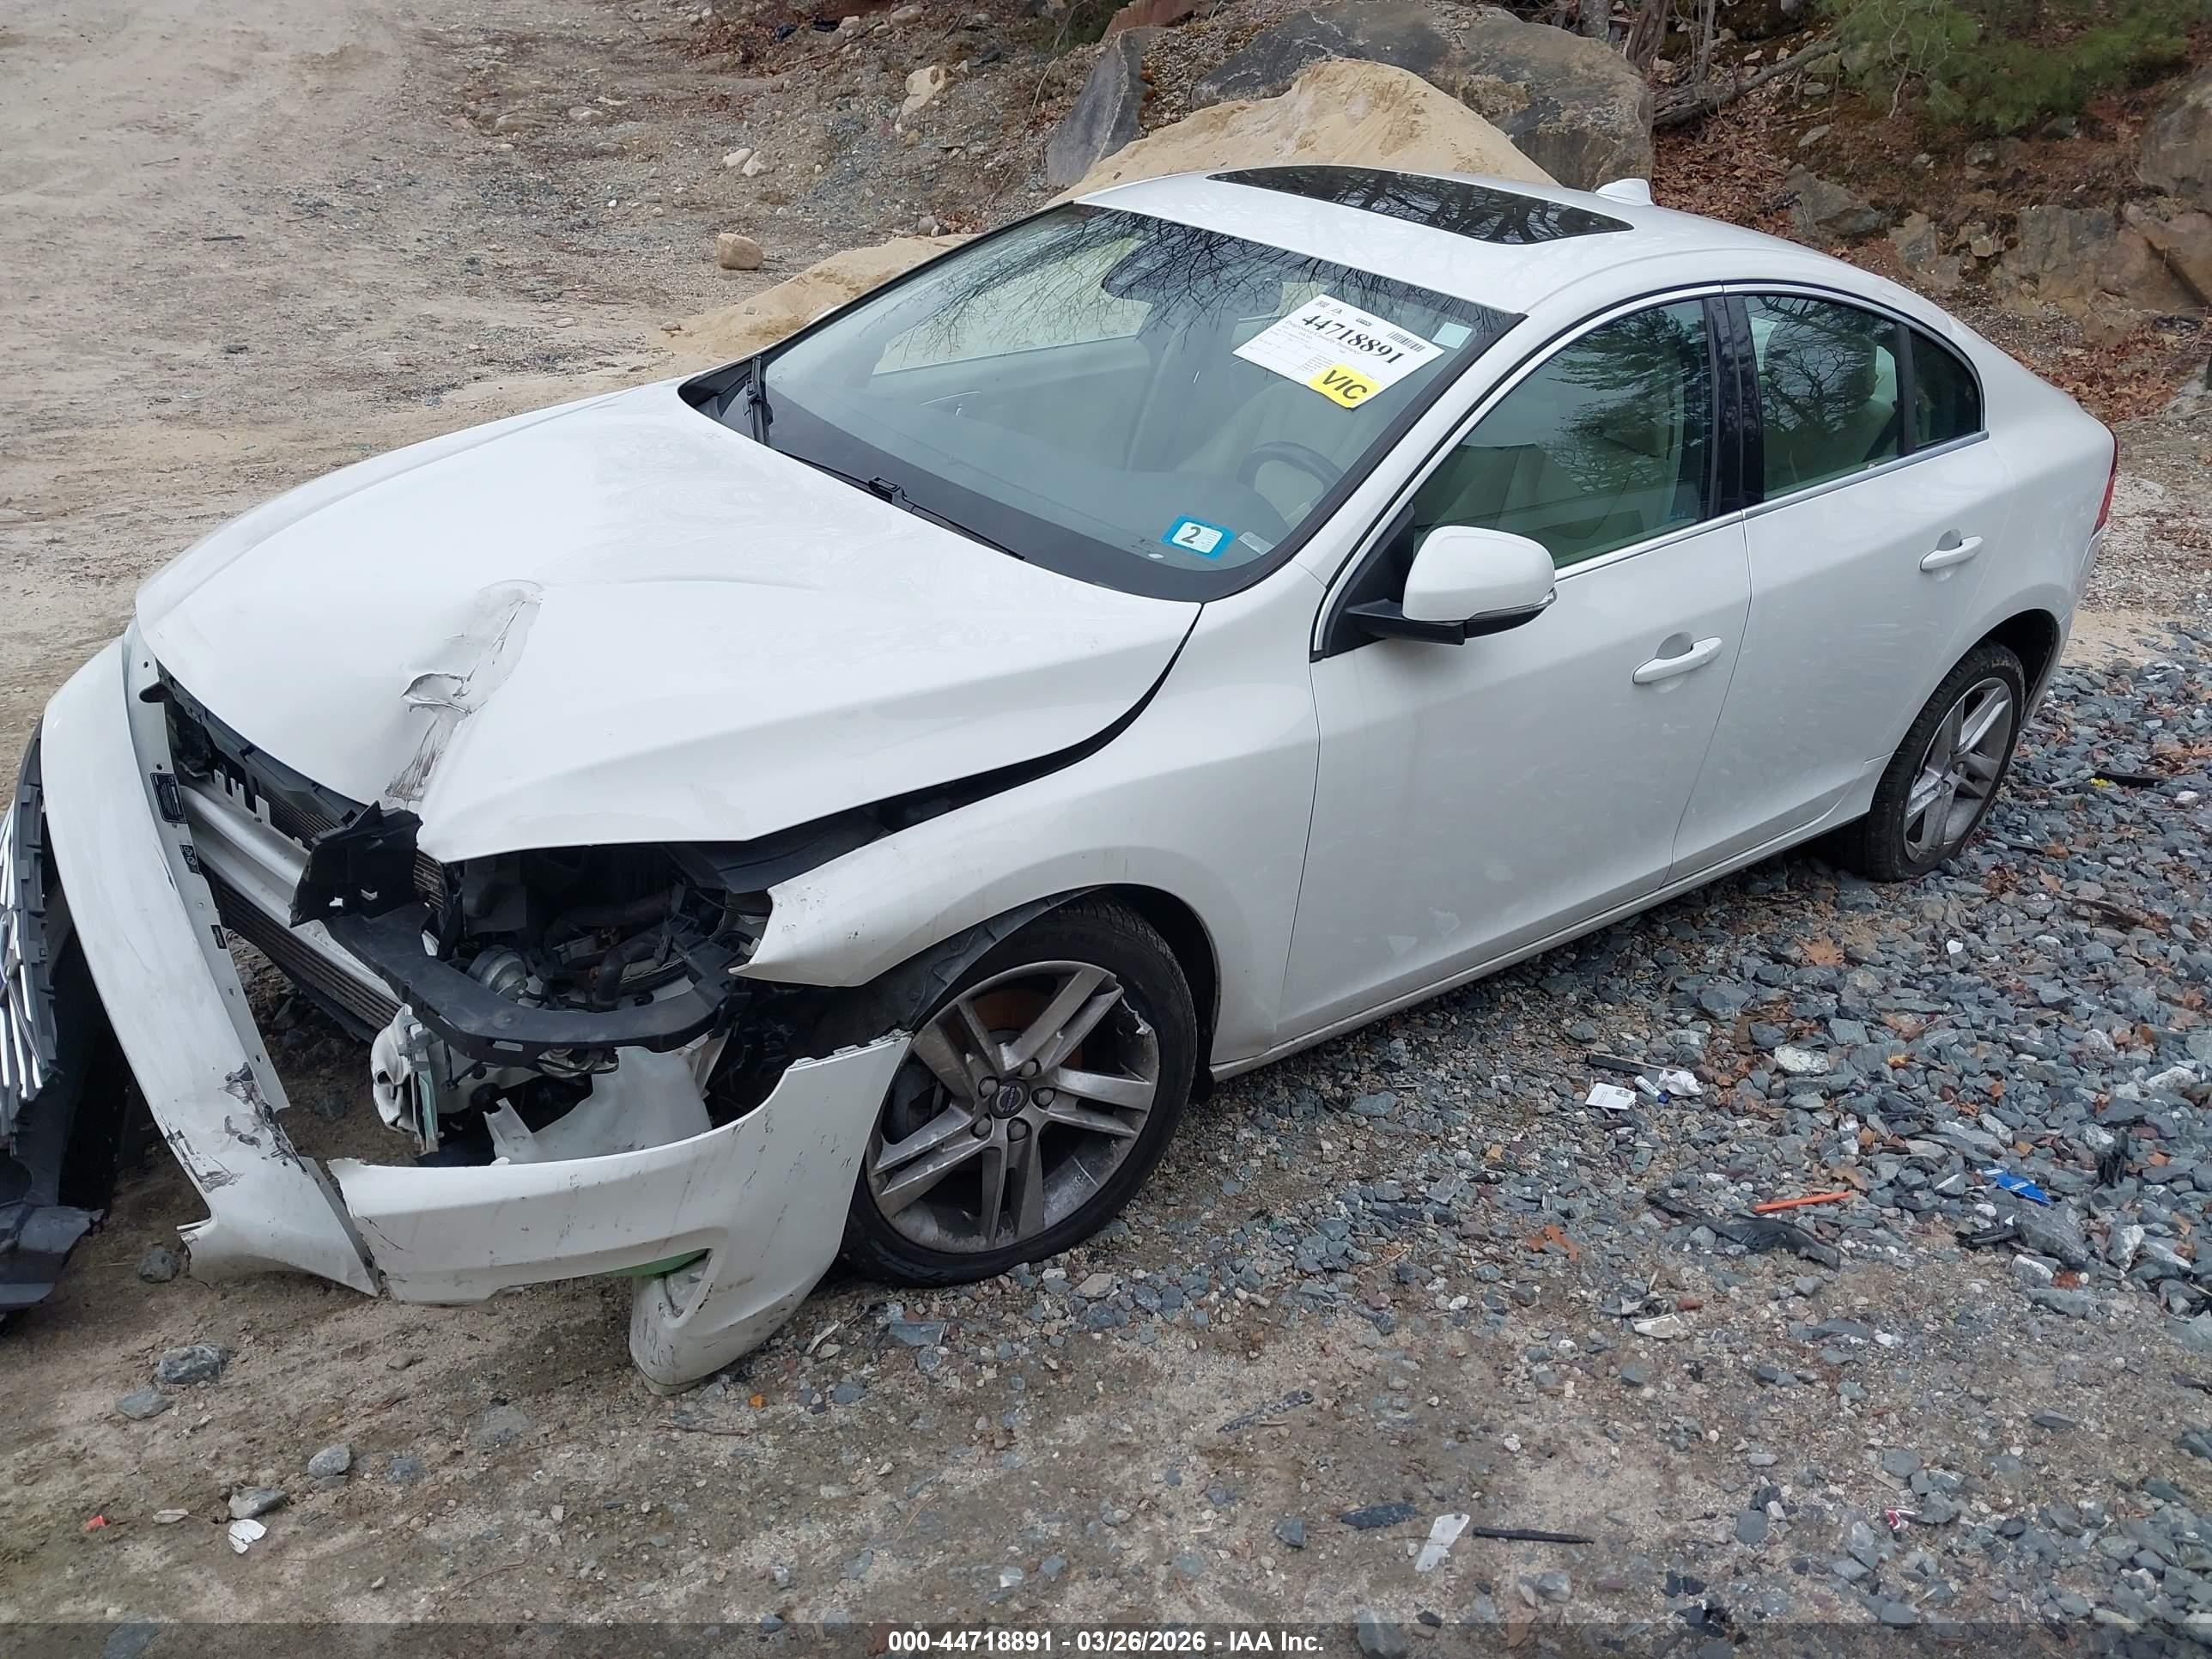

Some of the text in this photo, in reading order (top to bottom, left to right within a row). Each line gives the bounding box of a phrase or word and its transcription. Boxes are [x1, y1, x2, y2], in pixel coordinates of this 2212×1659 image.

[1302, 314, 1405, 363] 44718891
[1322, 370, 1368, 400] VIC
[1181, 526, 1201, 544] 2
